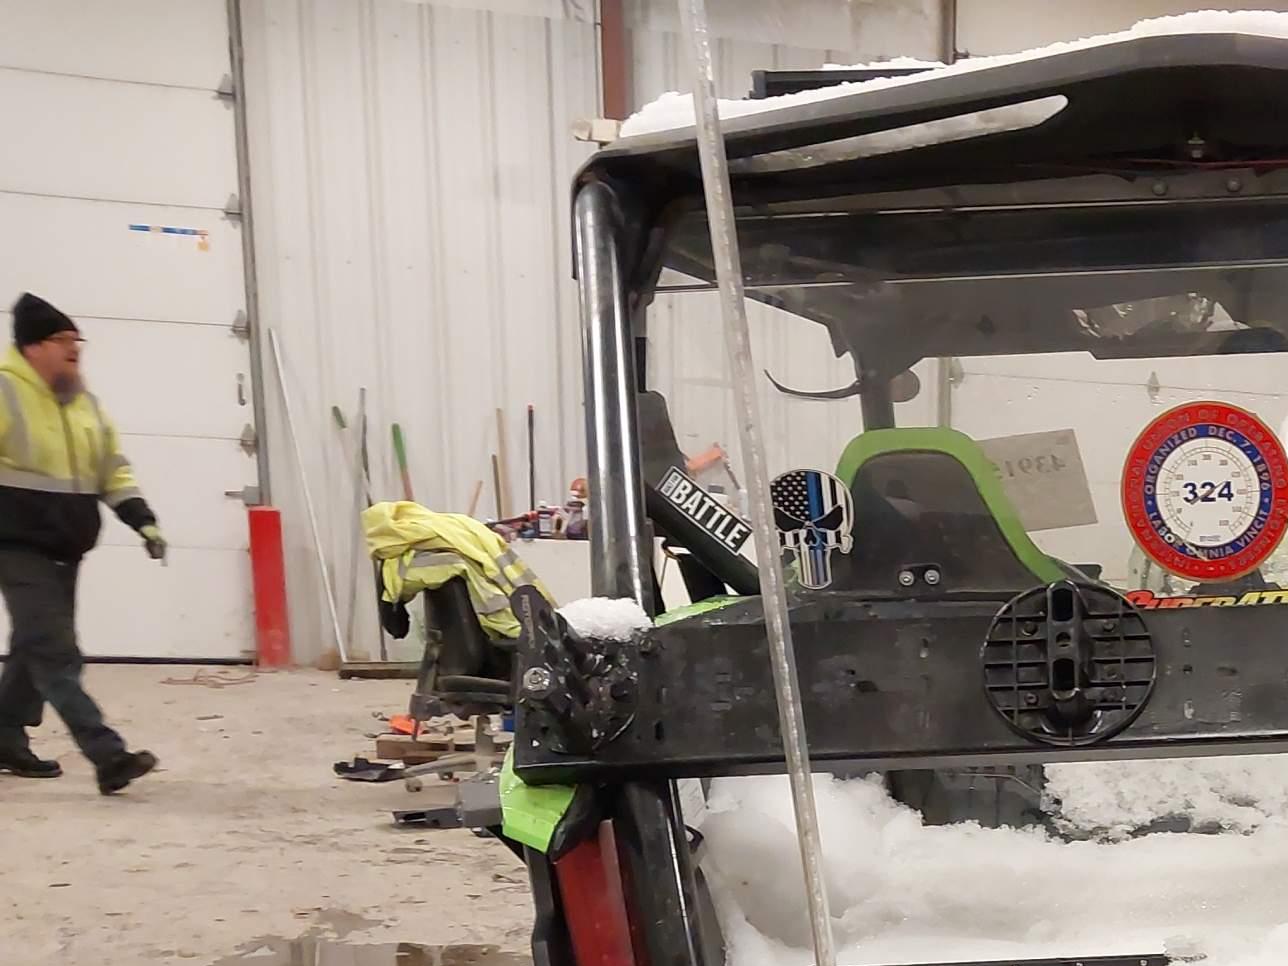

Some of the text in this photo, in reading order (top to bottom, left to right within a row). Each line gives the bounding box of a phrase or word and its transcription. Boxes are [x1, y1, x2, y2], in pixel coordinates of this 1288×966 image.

[1144, 426, 1197, 495] ORGANIZED
[1207, 425, 1239, 442] DEC.
[1252, 453, 1271, 489] 1896
[670, 476, 748, 549] BATTLE
[1182, 480, 1234, 503] 324
[1235, 508, 1268, 549] VINCIT
